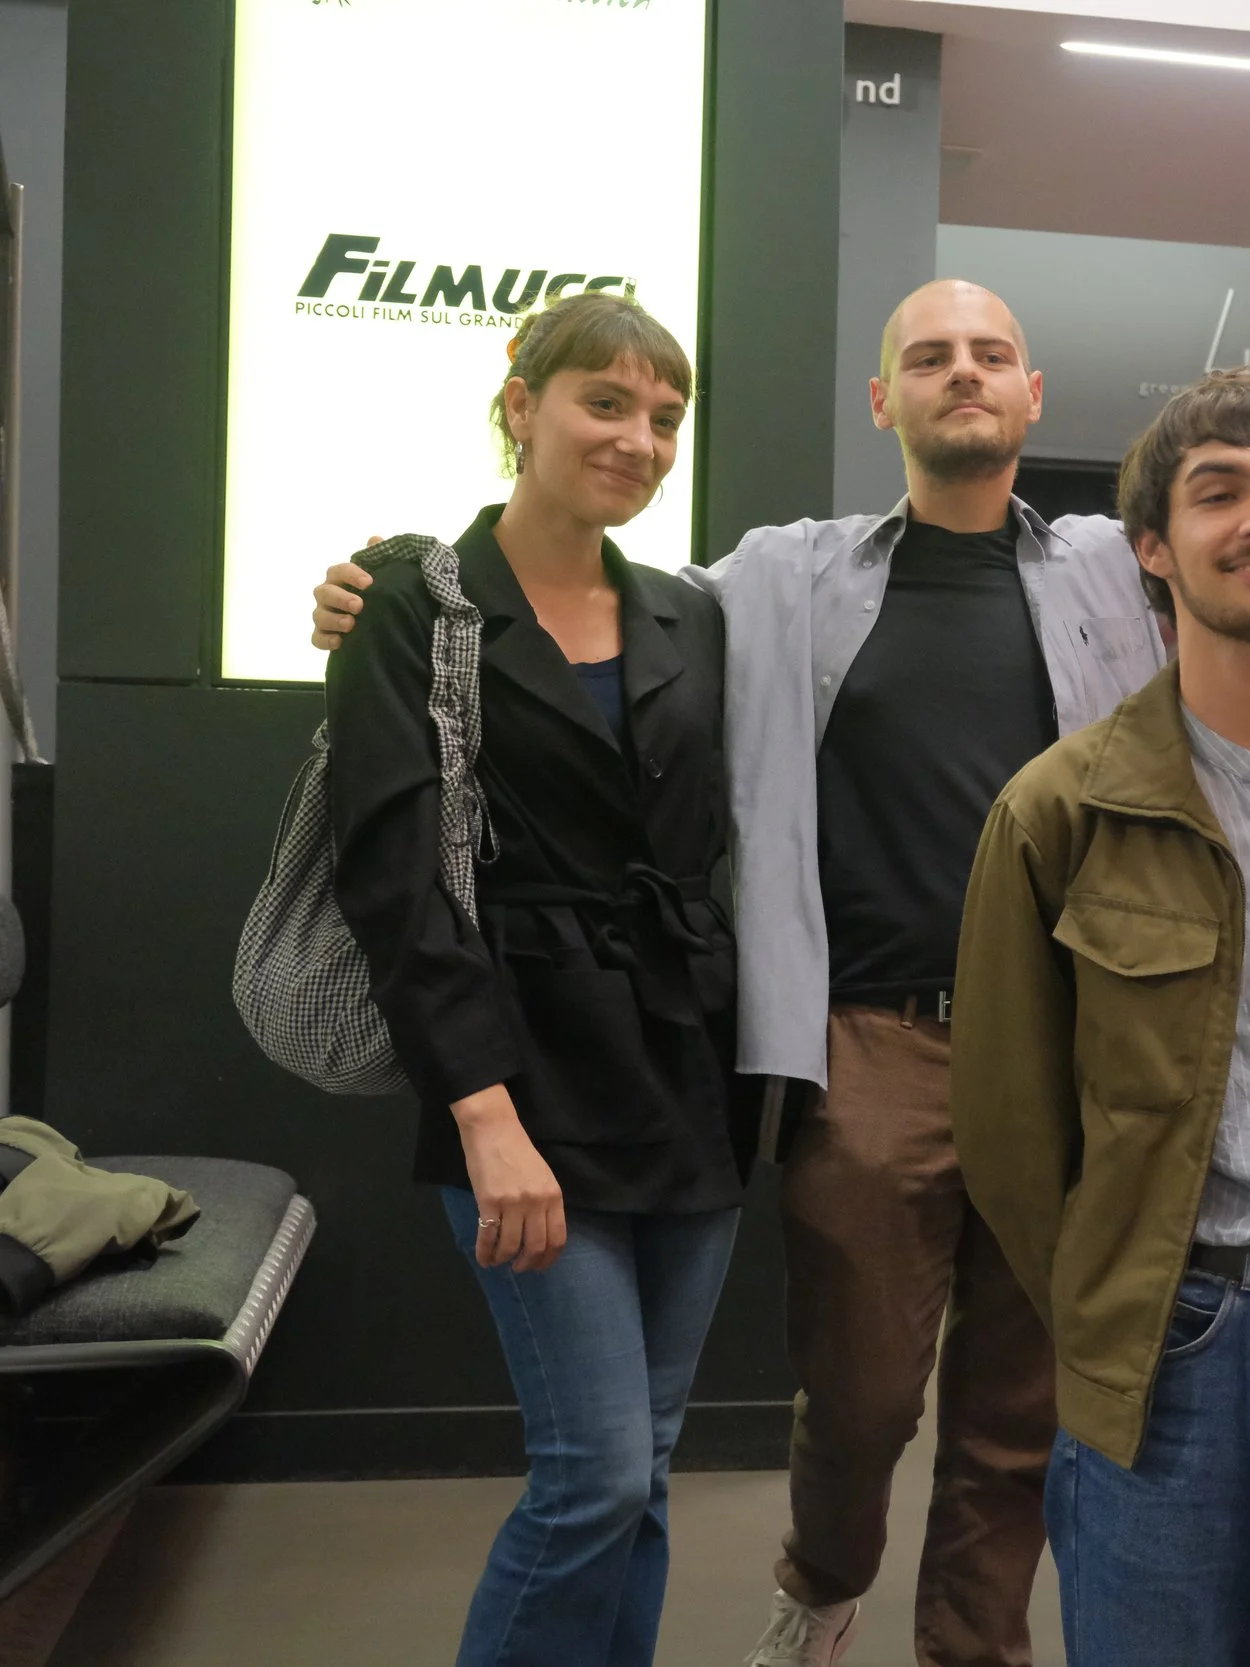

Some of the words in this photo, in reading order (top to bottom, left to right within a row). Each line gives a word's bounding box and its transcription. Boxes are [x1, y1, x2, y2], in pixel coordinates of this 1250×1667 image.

[295, 302, 365, 319] PICCOLI
[373, 307, 412, 322] FILM
[420, 310, 452, 325] SUL
